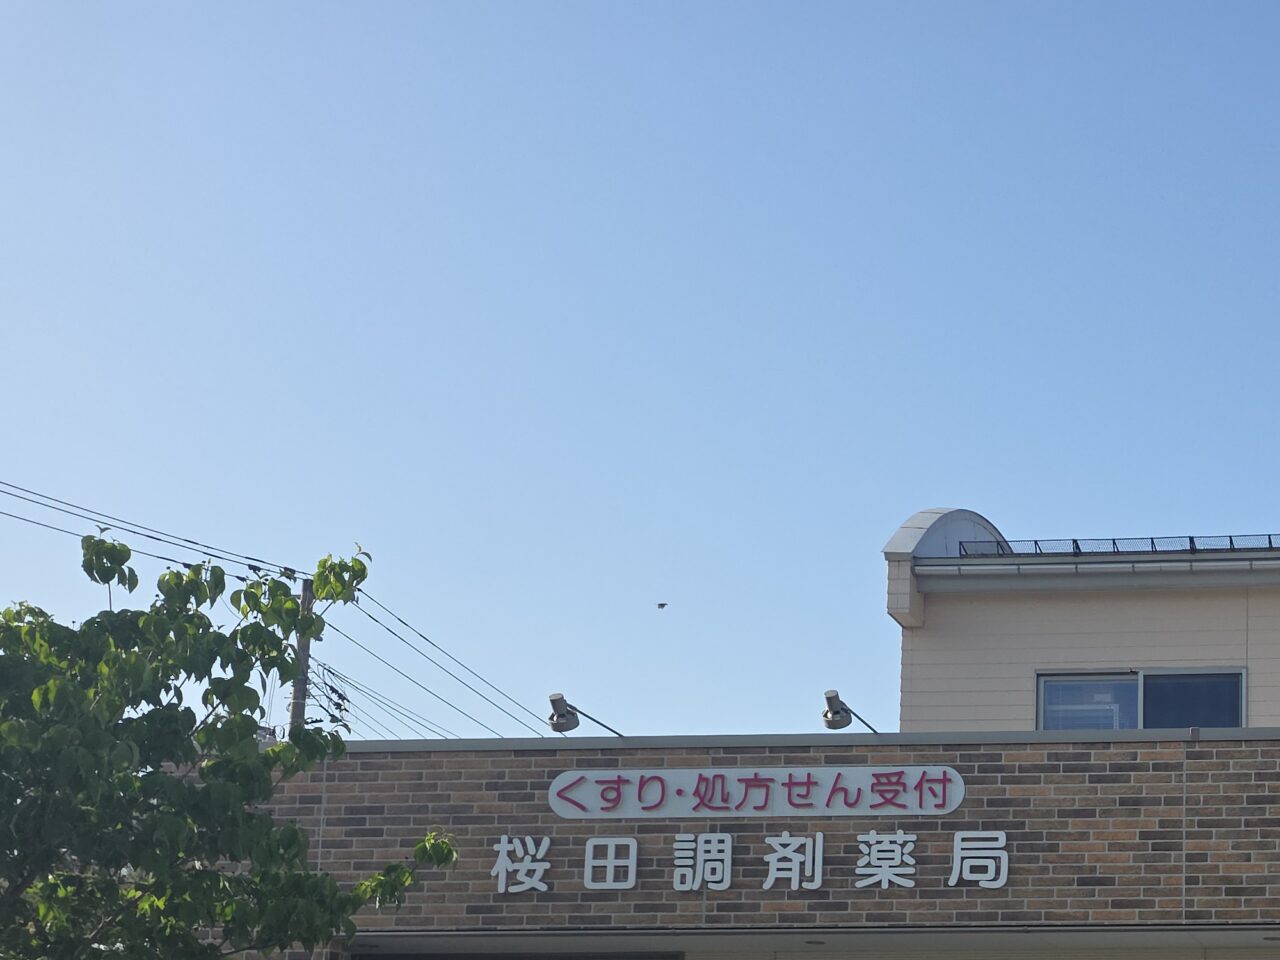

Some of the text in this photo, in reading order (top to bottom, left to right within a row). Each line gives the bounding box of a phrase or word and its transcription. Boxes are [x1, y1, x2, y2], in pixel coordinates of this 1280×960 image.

[555, 770, 954, 813] くすり・処方せん受付
[490, 829, 1009, 894] 桜田調剤薬局
